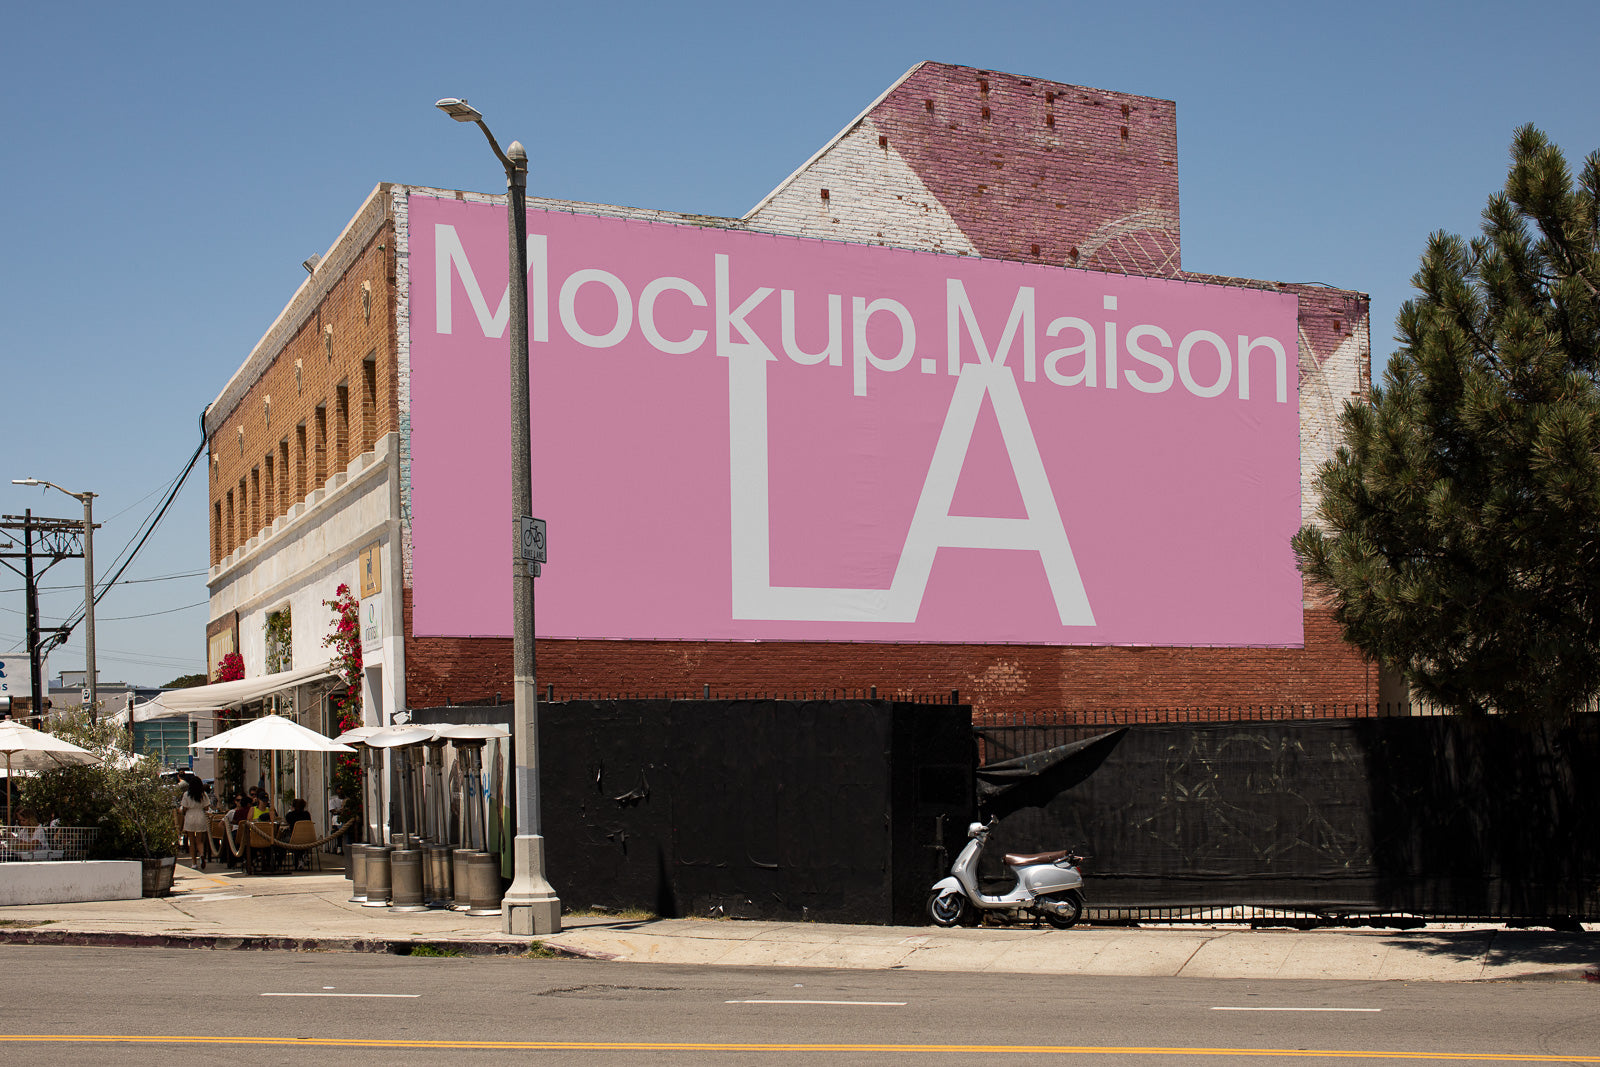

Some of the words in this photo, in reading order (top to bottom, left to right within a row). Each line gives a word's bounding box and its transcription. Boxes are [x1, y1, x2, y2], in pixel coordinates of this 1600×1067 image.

[434, 223, 1288, 403] Mockup.Maison
[524, 548, 532, 558] BIKE
[533, 550, 544, 560] LANE
[728, 344, 1097, 627] LA
